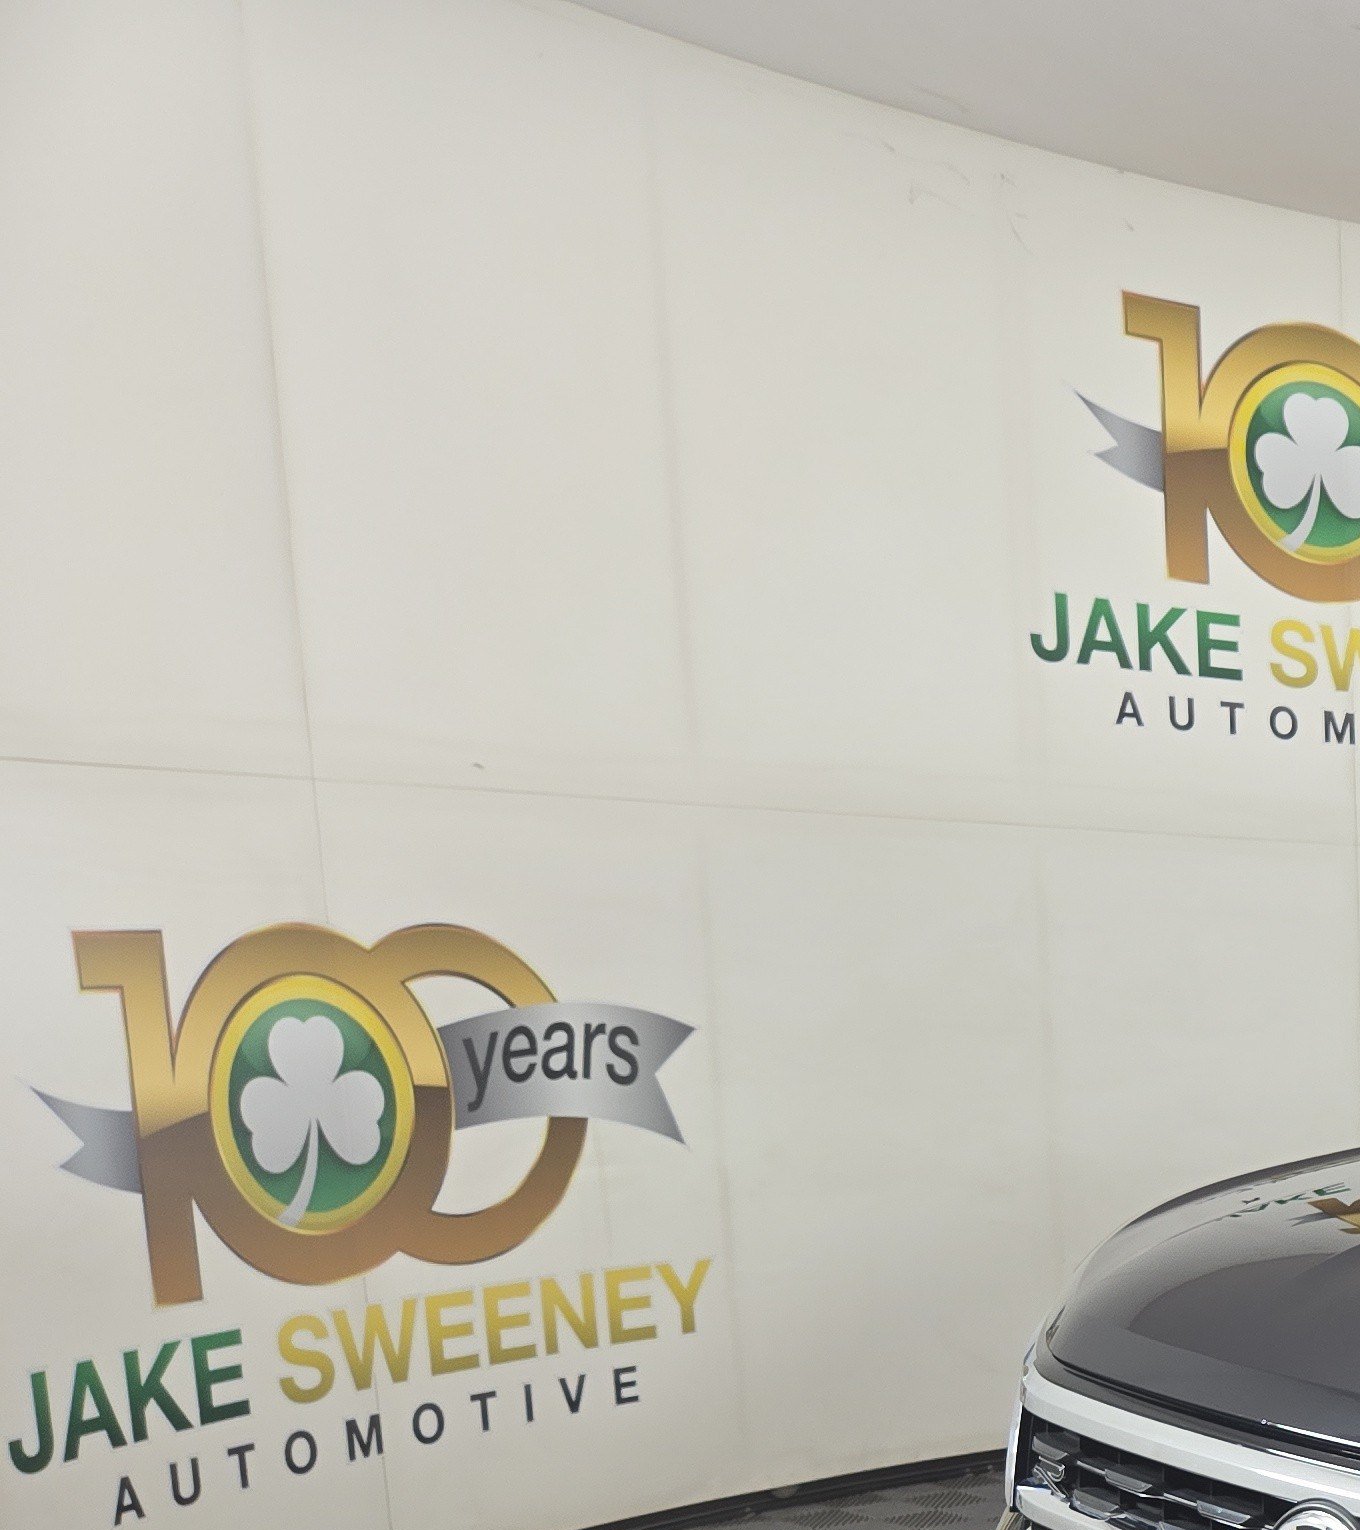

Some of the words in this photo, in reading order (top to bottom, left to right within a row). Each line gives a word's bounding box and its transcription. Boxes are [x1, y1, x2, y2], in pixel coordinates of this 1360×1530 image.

[1030, 591, 1243, 681] JAKE
[463, 1021, 640, 1111] years
[8, 1328, 251, 1475] JAKE
[277, 1259, 712, 1404] SWEENEY
[113, 1366, 641, 1527] AUTOMOTIVE
